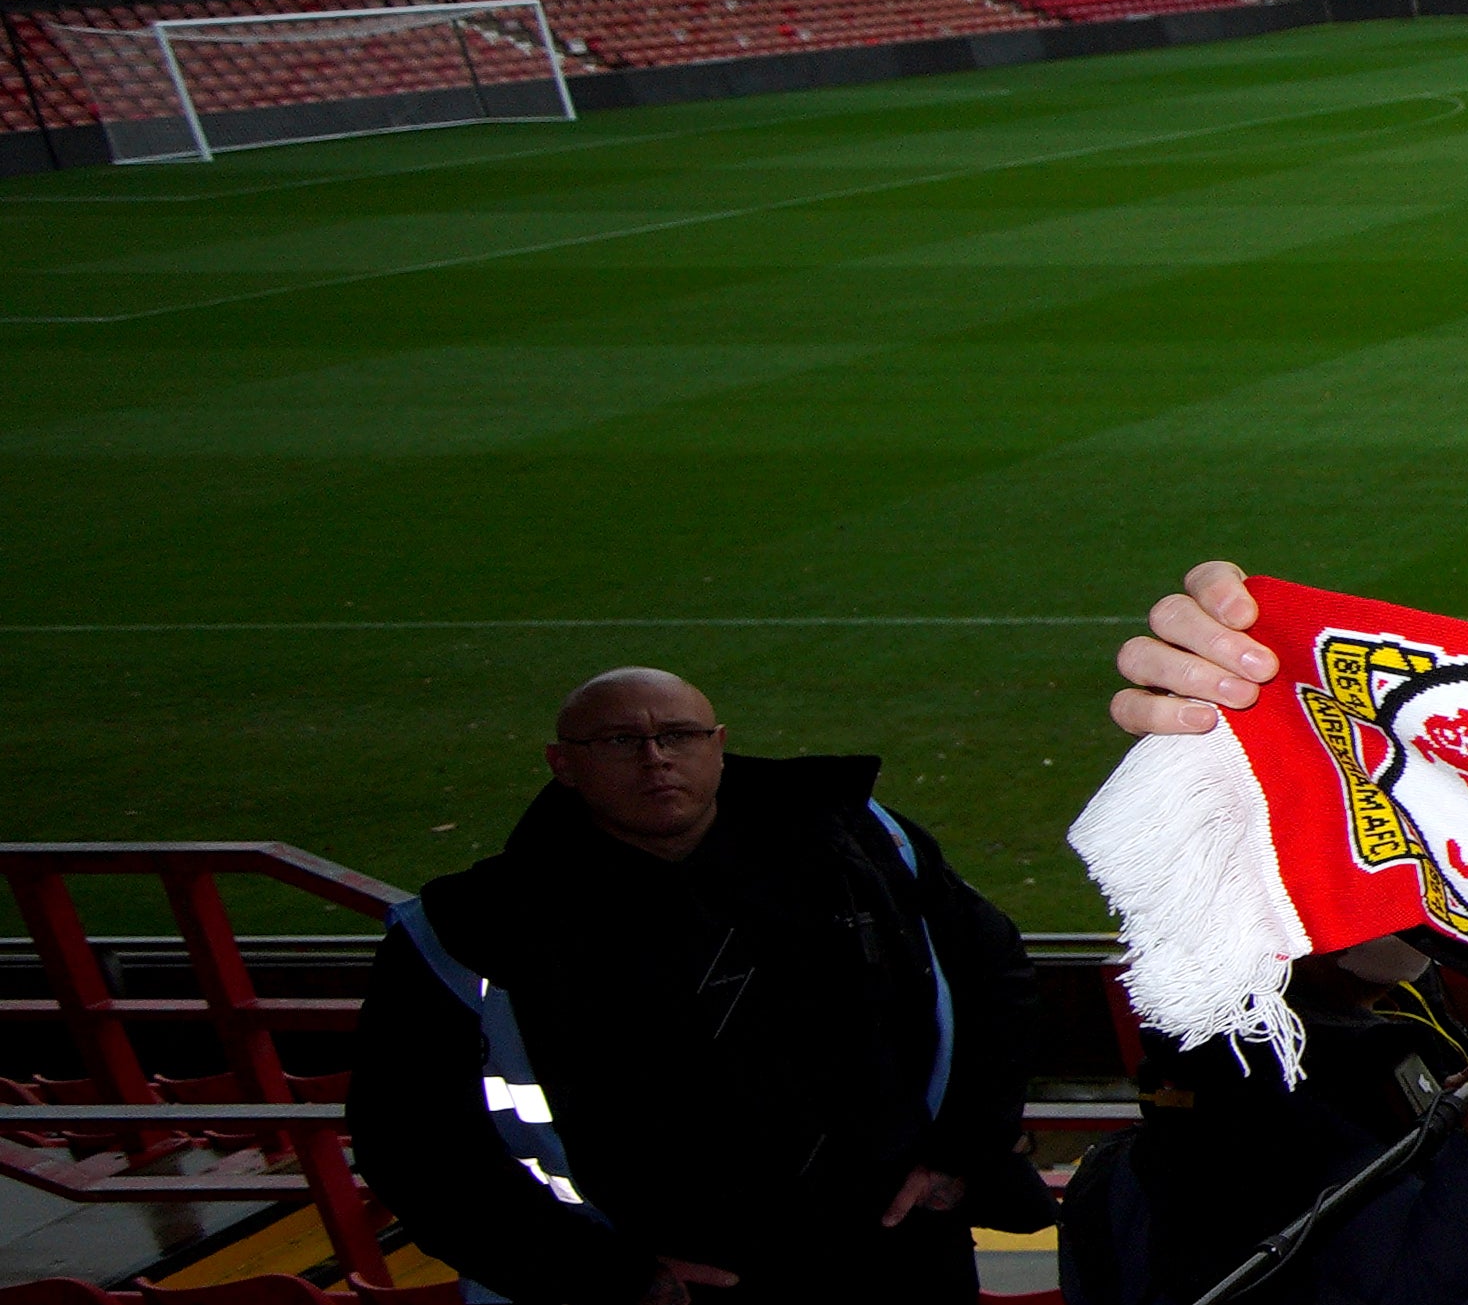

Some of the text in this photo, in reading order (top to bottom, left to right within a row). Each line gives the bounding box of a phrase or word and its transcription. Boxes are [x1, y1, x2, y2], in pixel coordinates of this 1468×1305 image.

[1331, 645, 1367, 717] 1864
[1314, 697, 1401, 859] WREXHAM AFC
